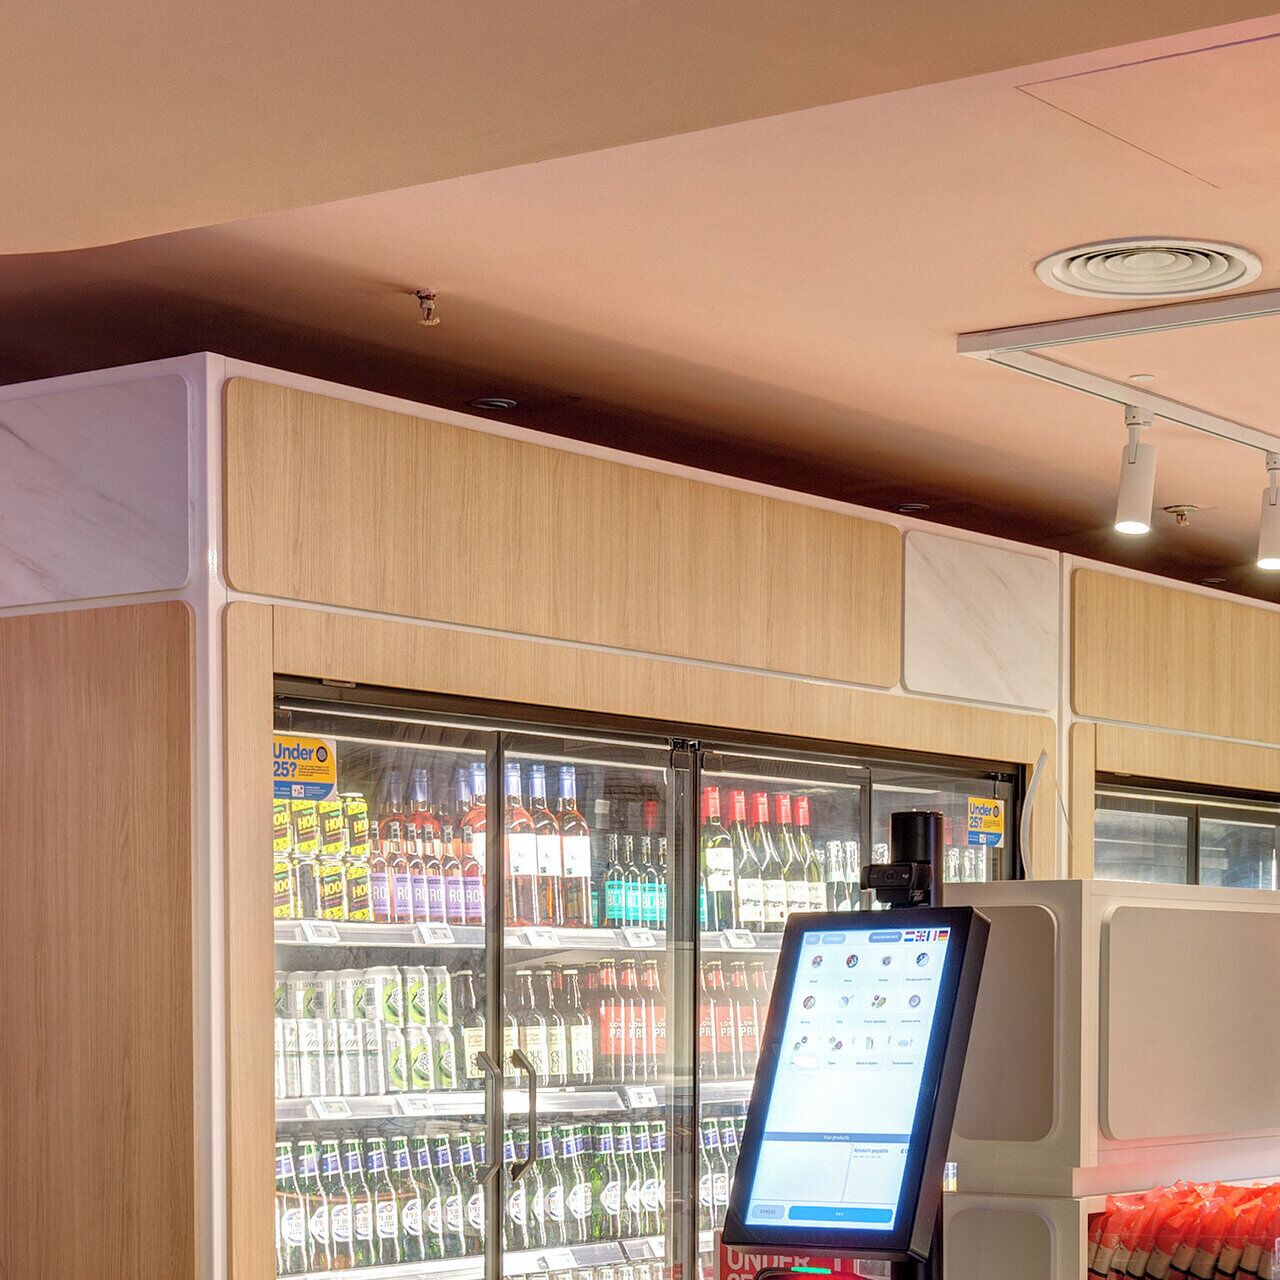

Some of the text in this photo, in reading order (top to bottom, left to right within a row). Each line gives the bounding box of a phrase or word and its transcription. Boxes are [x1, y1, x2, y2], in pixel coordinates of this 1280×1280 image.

[273, 743, 314, 761] Under
[273, 761, 297, 778] 25?
[970, 803, 992, 816] Under
[970, 817, 983, 828] 25?
